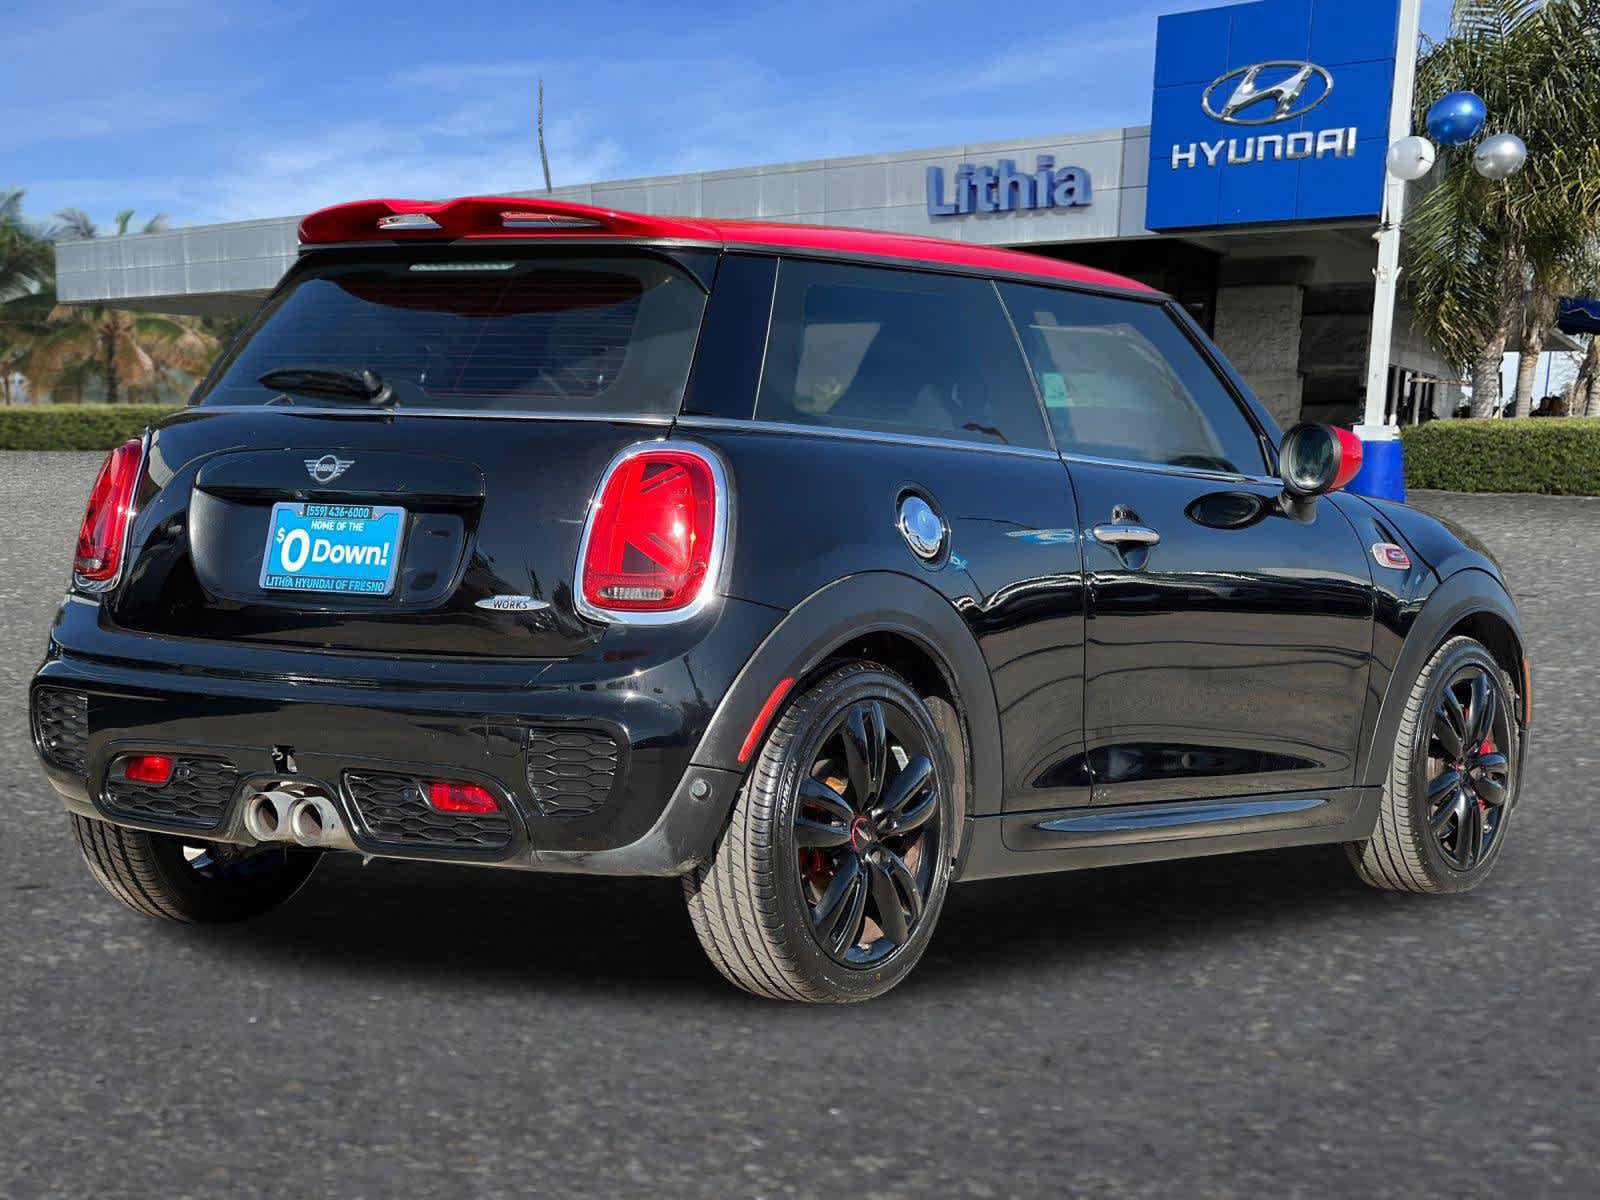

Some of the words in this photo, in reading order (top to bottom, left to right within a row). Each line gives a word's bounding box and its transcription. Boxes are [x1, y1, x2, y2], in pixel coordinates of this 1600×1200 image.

[1171, 127, 1357, 169] HYUNDAI
[926, 155, 1092, 216] Lithia
[306, 505, 327, 517] (559)
[328, 506, 370, 518] 436-6000
[311, 520, 335, 531] HOME
[336, 521, 347, 531] OF
[348, 522, 365, 532] THE
[312, 539, 390, 566] Down!
[294, 578, 334, 590] HYUNDAI
[335, 579, 348, 591] OF
[349, 580, 385, 593] FRESNO
[493, 600, 528, 609] WORKS
